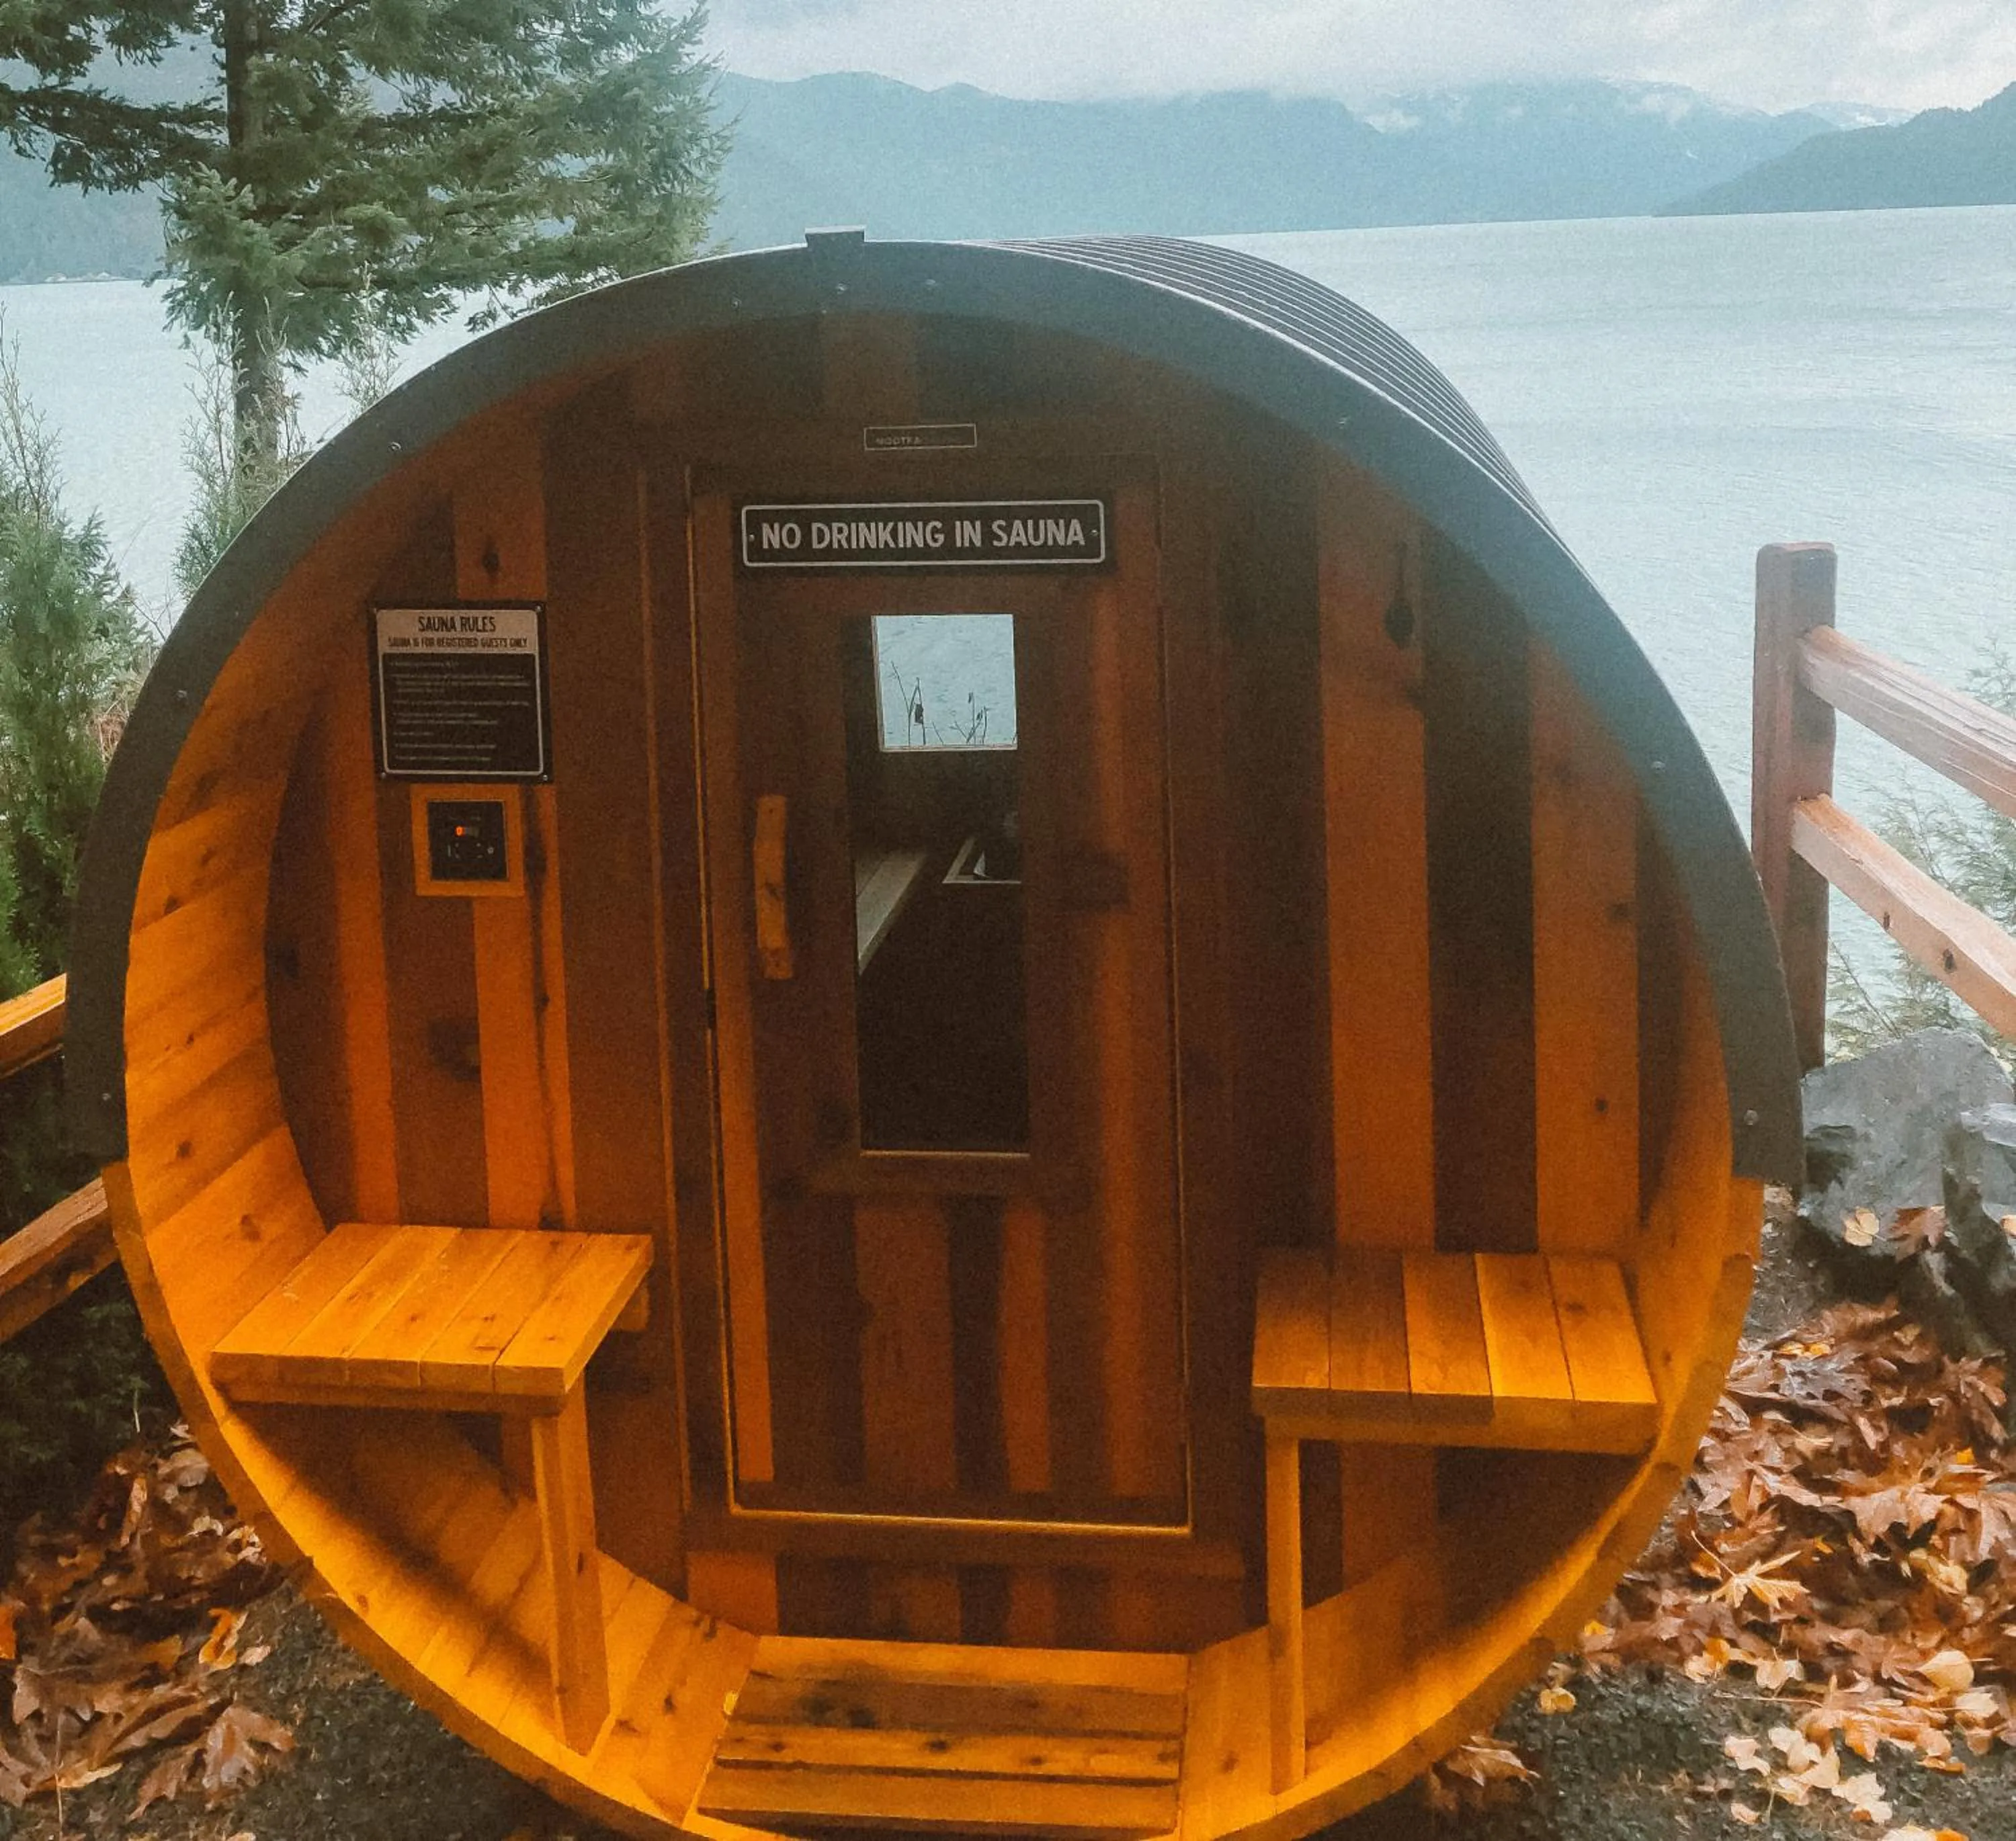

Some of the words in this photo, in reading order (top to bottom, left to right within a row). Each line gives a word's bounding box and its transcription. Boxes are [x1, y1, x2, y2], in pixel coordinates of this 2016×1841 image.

[761, 521, 802, 549] NO
[811, 520, 945, 549] DRINKING
[954, 519, 982, 548] IN
[992, 518, 1086, 548] SAUNA
[417, 615, 456, 632] SAUNA
[460, 615, 496, 632] RULES
[421, 637, 435, 647] FOR
[436, 637, 479, 648] REGISTERED
[480, 637, 507, 648] GUESTS
[509, 637, 528, 648] ONLY
